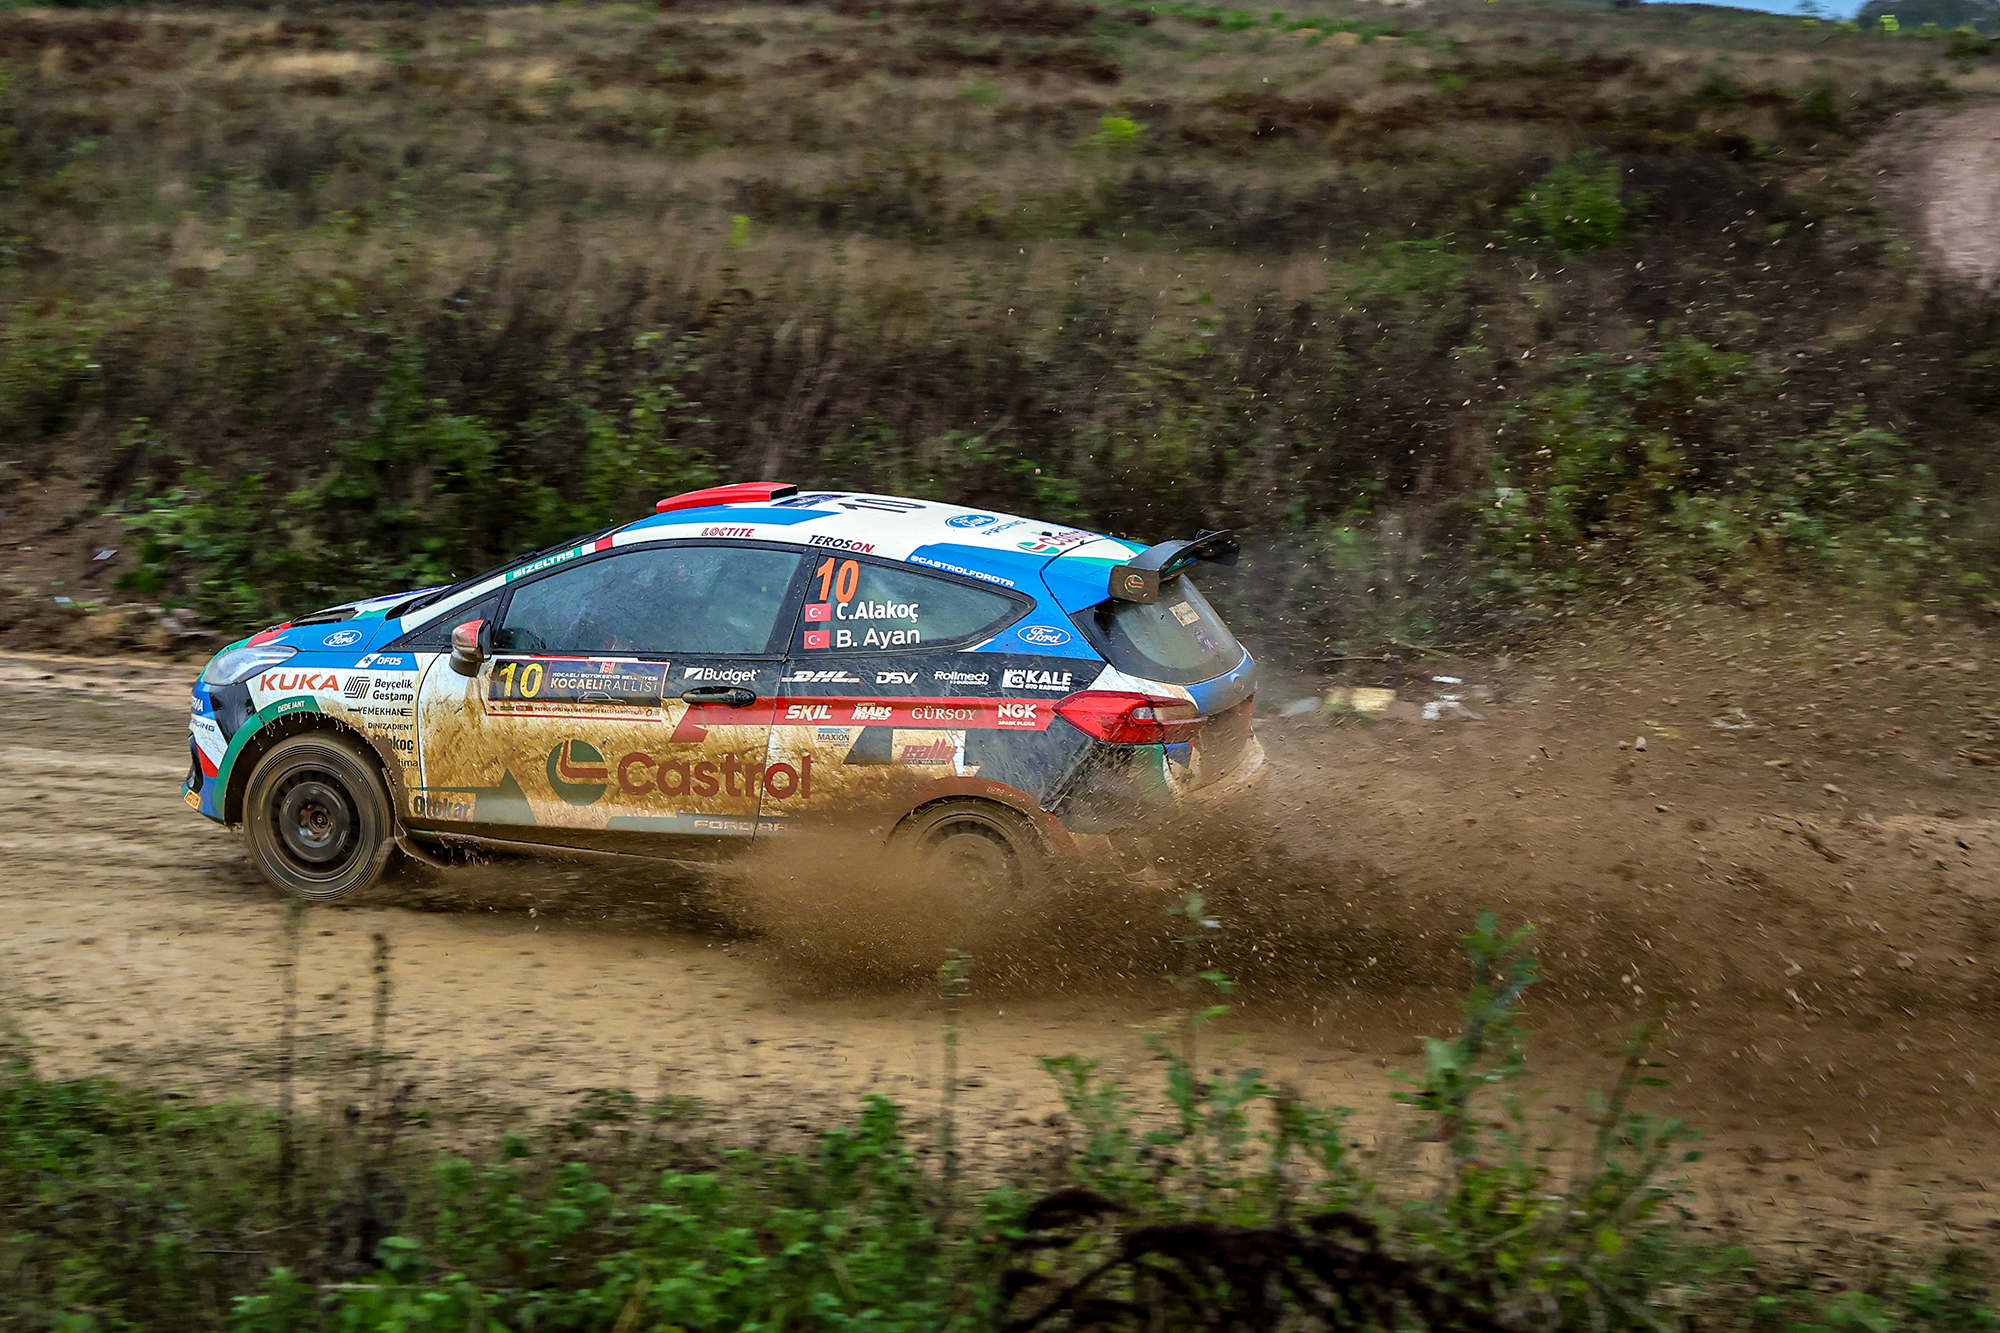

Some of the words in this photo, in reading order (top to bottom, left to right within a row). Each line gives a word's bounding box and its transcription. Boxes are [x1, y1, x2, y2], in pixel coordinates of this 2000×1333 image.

[701, 527, 754, 537] LOCTITE
[808, 535, 875, 553] TEROSON
[910, 555, 1015, 587] @CASTROLFORDTR
[816, 557, 860, 603] 10
[328, 631, 355, 646] Ford
[836, 629, 858, 648] B.
[863, 627, 920, 649] Ayan
[1026, 627, 1062, 645] Ford
[259, 674, 339, 691] KUKA
[499, 662, 543, 698] 10
[704, 668, 756, 684] Budget
[791, 670, 850, 683] DHL
[875, 671, 918, 684] DSV
[933, 670, 990, 681] Rollmech
[1026, 670, 1073, 686] KALE
[374, 678, 413, 690] Beyçelik
[372, 690, 414, 704] Gestamp
[785, 705, 832, 721] SKIL
[911, 705, 976, 721] GÜRSOY
[997, 703, 1038, 719] NGK
[817, 733, 850, 741] MAXION
[618, 752, 812, 799] Castrol
